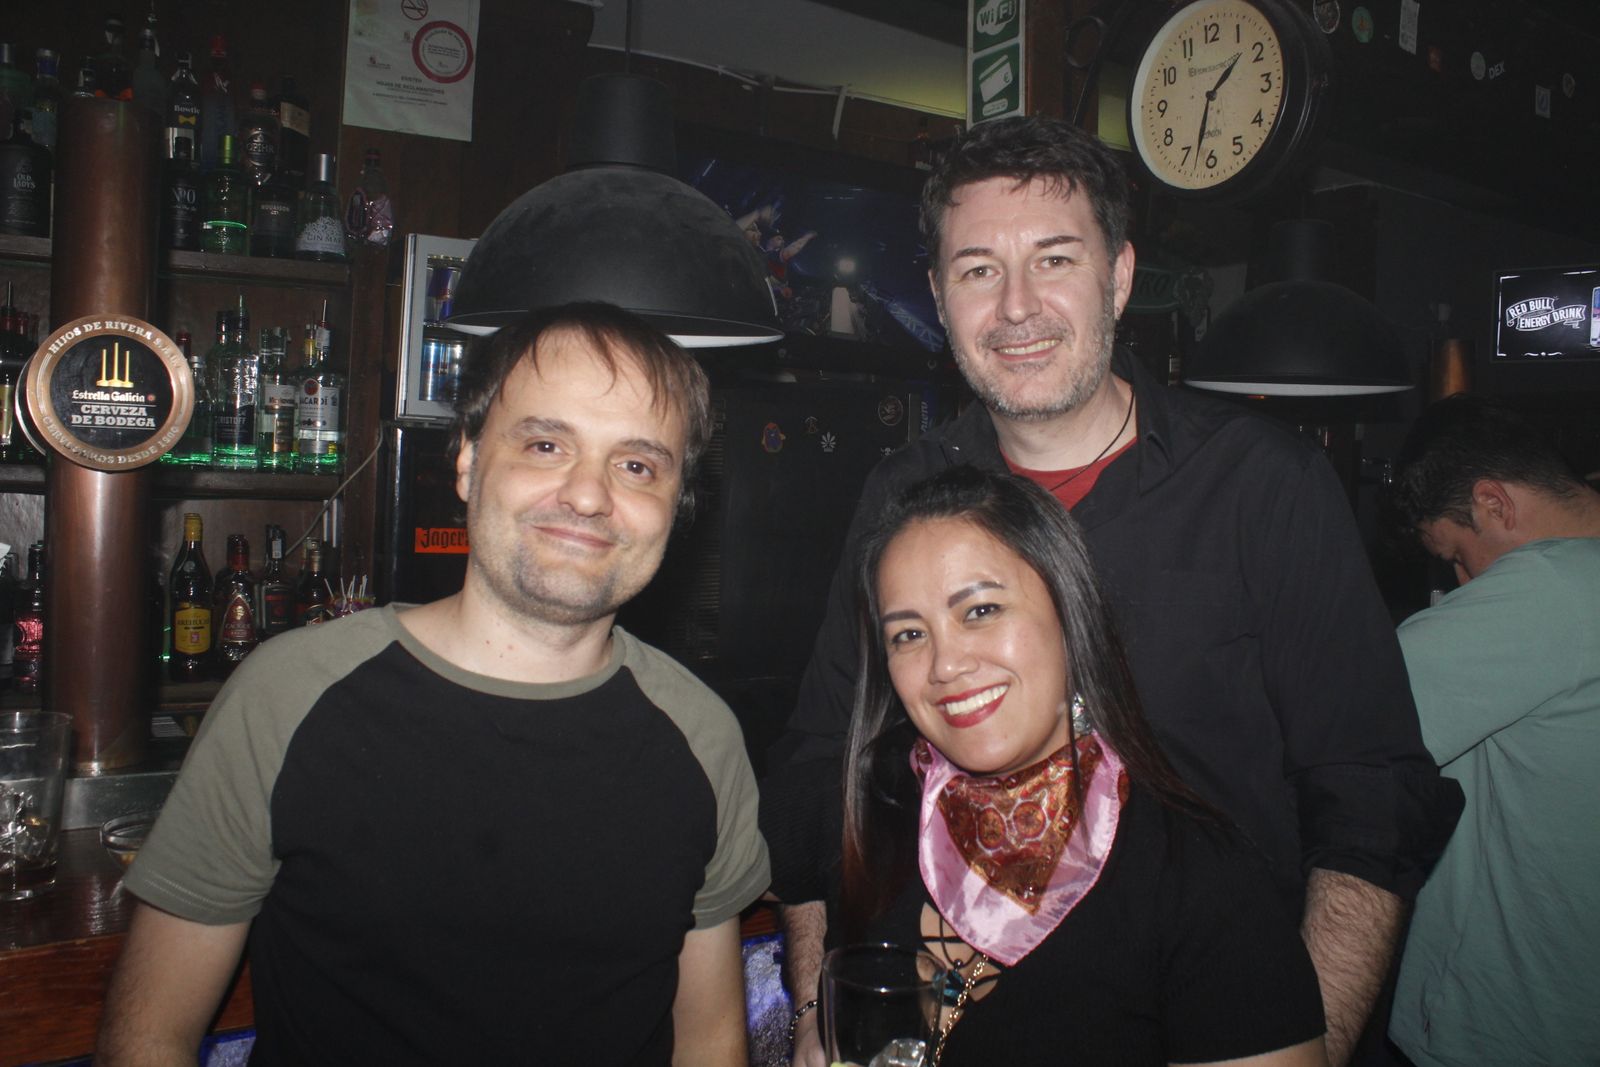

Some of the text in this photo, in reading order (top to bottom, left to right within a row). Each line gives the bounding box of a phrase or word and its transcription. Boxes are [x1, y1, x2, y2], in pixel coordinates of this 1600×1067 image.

[1204, 22, 1221, 45] 12
[1235, 23, 1241, 45] 1
[1182, 37, 1193, 60] 11
[1251, 41, 1265, 64] 2
[1163, 66, 1177, 88] 10
[1259, 71, 1273, 94] 3
[1156, 99, 1168, 118] 9
[1250, 107, 1263, 128] 4
[1163, 127, 1174, 147] 8
[1232, 135, 1245, 157] 5
[1180, 145, 1193, 167] 7
[1205, 149, 1218, 169] 6
[1508, 299, 1552, 318] RED BULL
[1519, 307, 1583, 329] ENERGY DRINK
[49, 327, 82, 354] HIJOS
[82, 321, 103, 333] DE
[105, 321, 152, 340] RIVERA
[72, 389, 146, 403] Estrella Galicia
[71, 414, 157, 429] DE BODEGA
[80, 404, 148, 417] CERVEZA
[117, 443, 159, 464] DESDE
